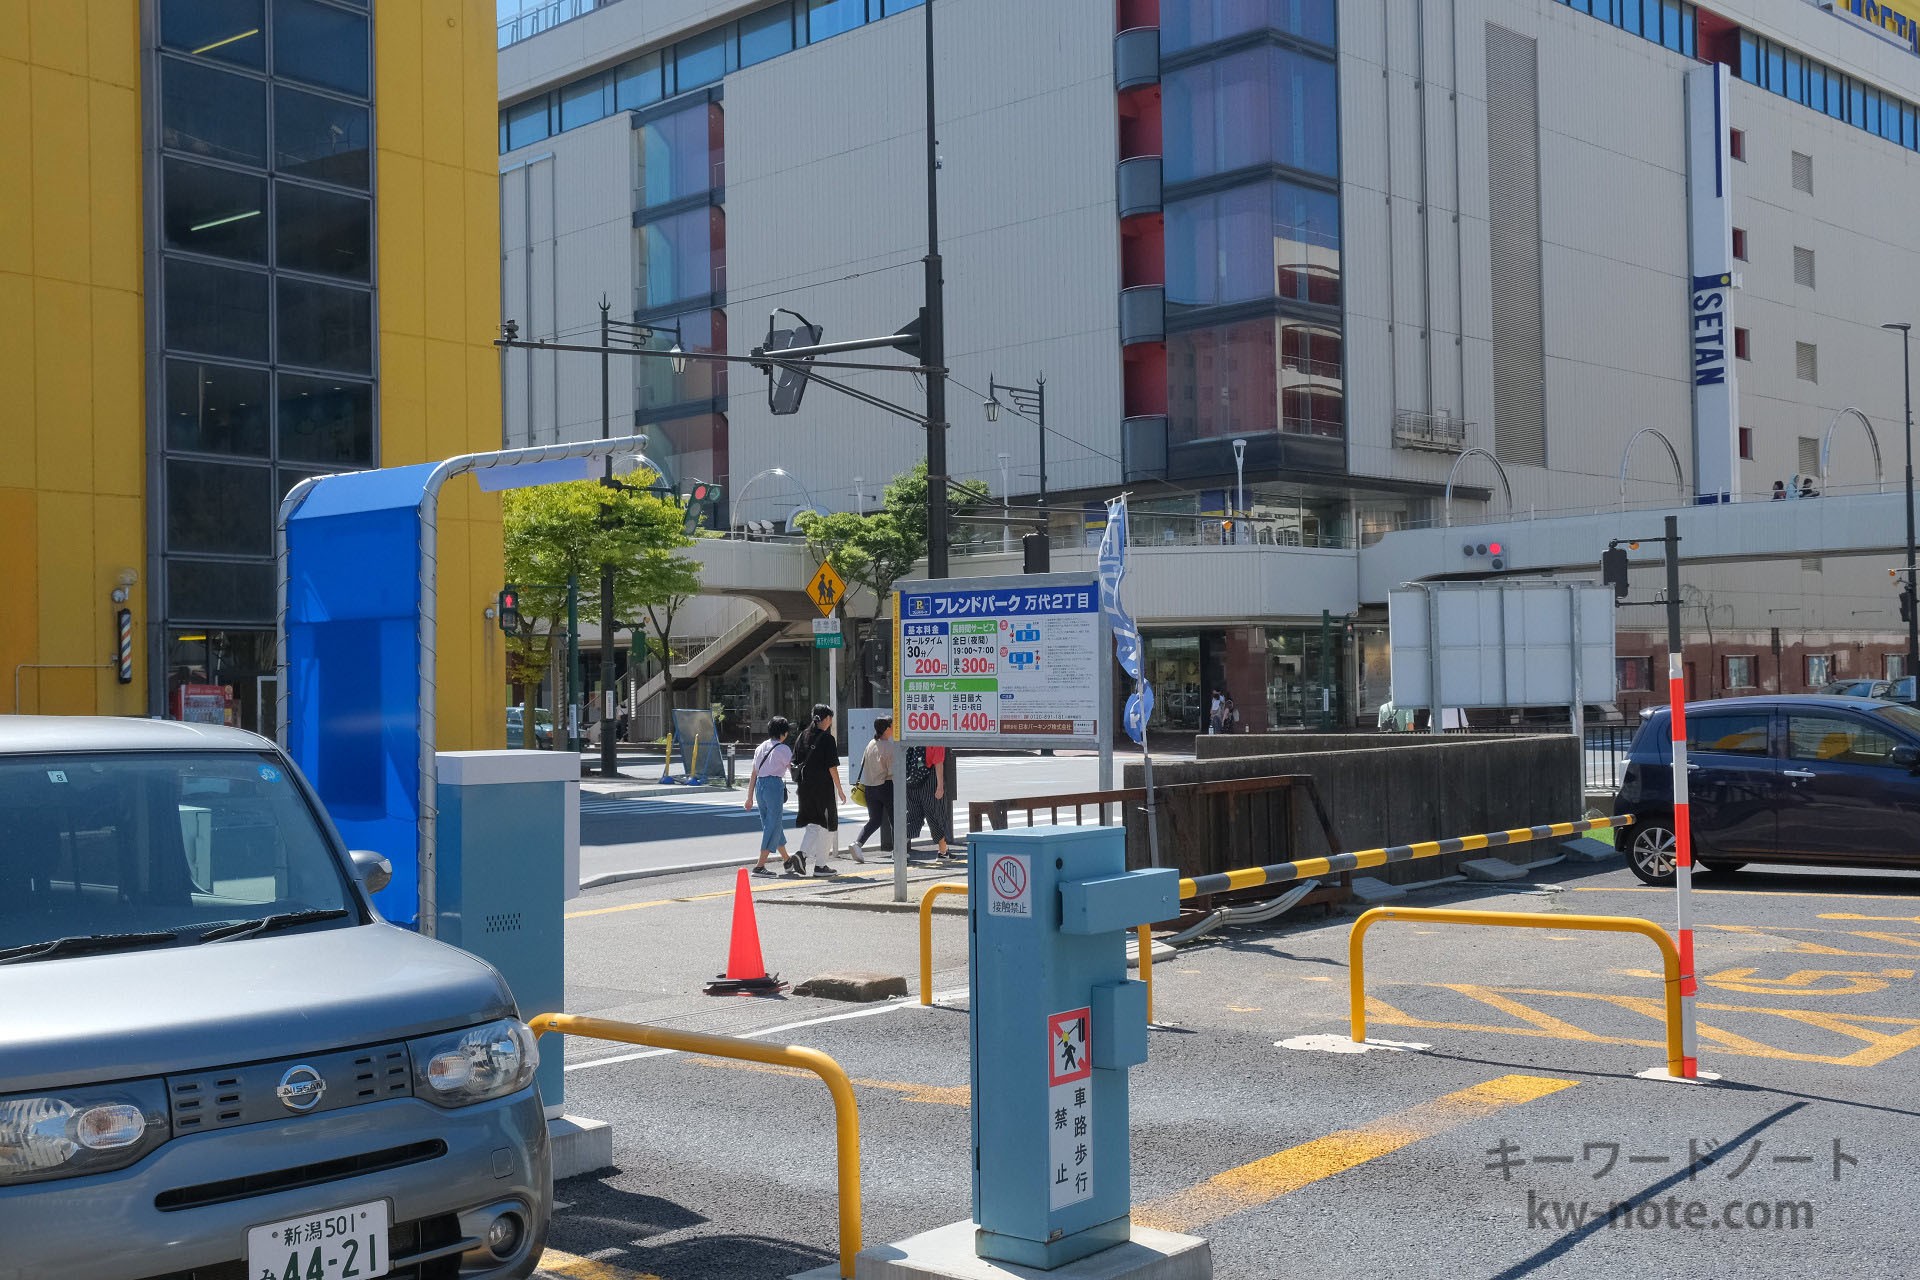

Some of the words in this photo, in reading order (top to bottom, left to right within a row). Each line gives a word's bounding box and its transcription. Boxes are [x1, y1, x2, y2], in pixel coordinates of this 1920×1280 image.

[1693, 271, 1732, 387] ISETAN
[935, 595, 1021, 614] フレンドパーク
[1025, 592, 1089, 611] 万代2丁目
[907, 625, 939, 635] 基本料金
[952, 623, 995, 633] 長時間サービス
[905, 637, 943, 645] オールタイム
[915, 658, 948, 674] 200円
[953, 658, 960, 674] 最大
[961, 657, 995, 673] 300円
[908, 681, 957, 691] 長時間サービス
[906, 694, 935, 703] 当日最大
[952, 694, 982, 703] 当日最大
[908, 712, 949, 731] 600円
[992, 900, 1028, 915] 接触禁止
[282, 1081, 324, 1096] NISSAN
[1054, 1107, 1069, 1185] 禁止
[1073, 1087, 1088, 1195] 車路歩行
[282, 1234, 376, 1280] 44-21
